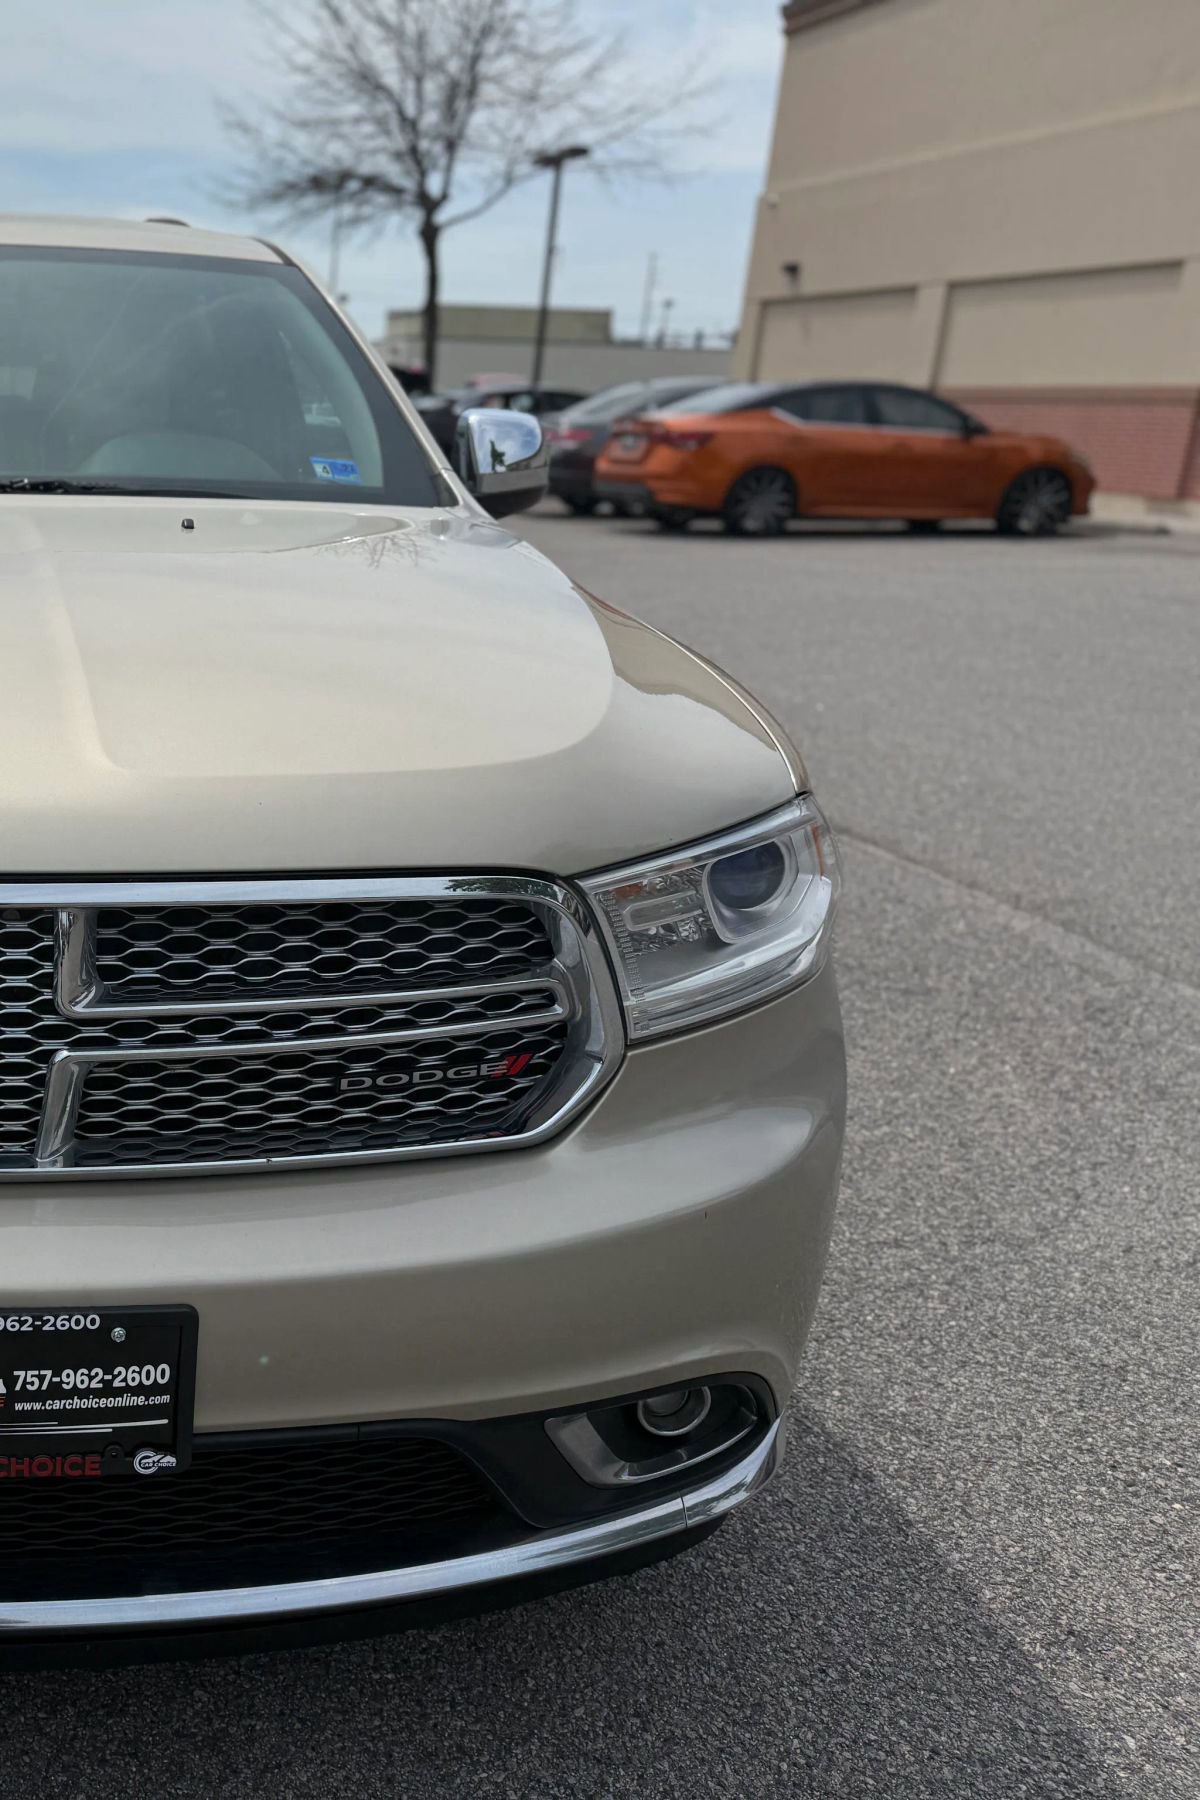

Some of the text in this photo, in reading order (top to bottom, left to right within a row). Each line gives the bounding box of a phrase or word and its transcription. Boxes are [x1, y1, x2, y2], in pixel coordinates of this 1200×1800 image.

[339, 1061, 509, 1091] DODGE
[13, 1363, 171, 1391] 757-962-2600
[14, 1393, 171, 1411] www.carchoiceonline.com
